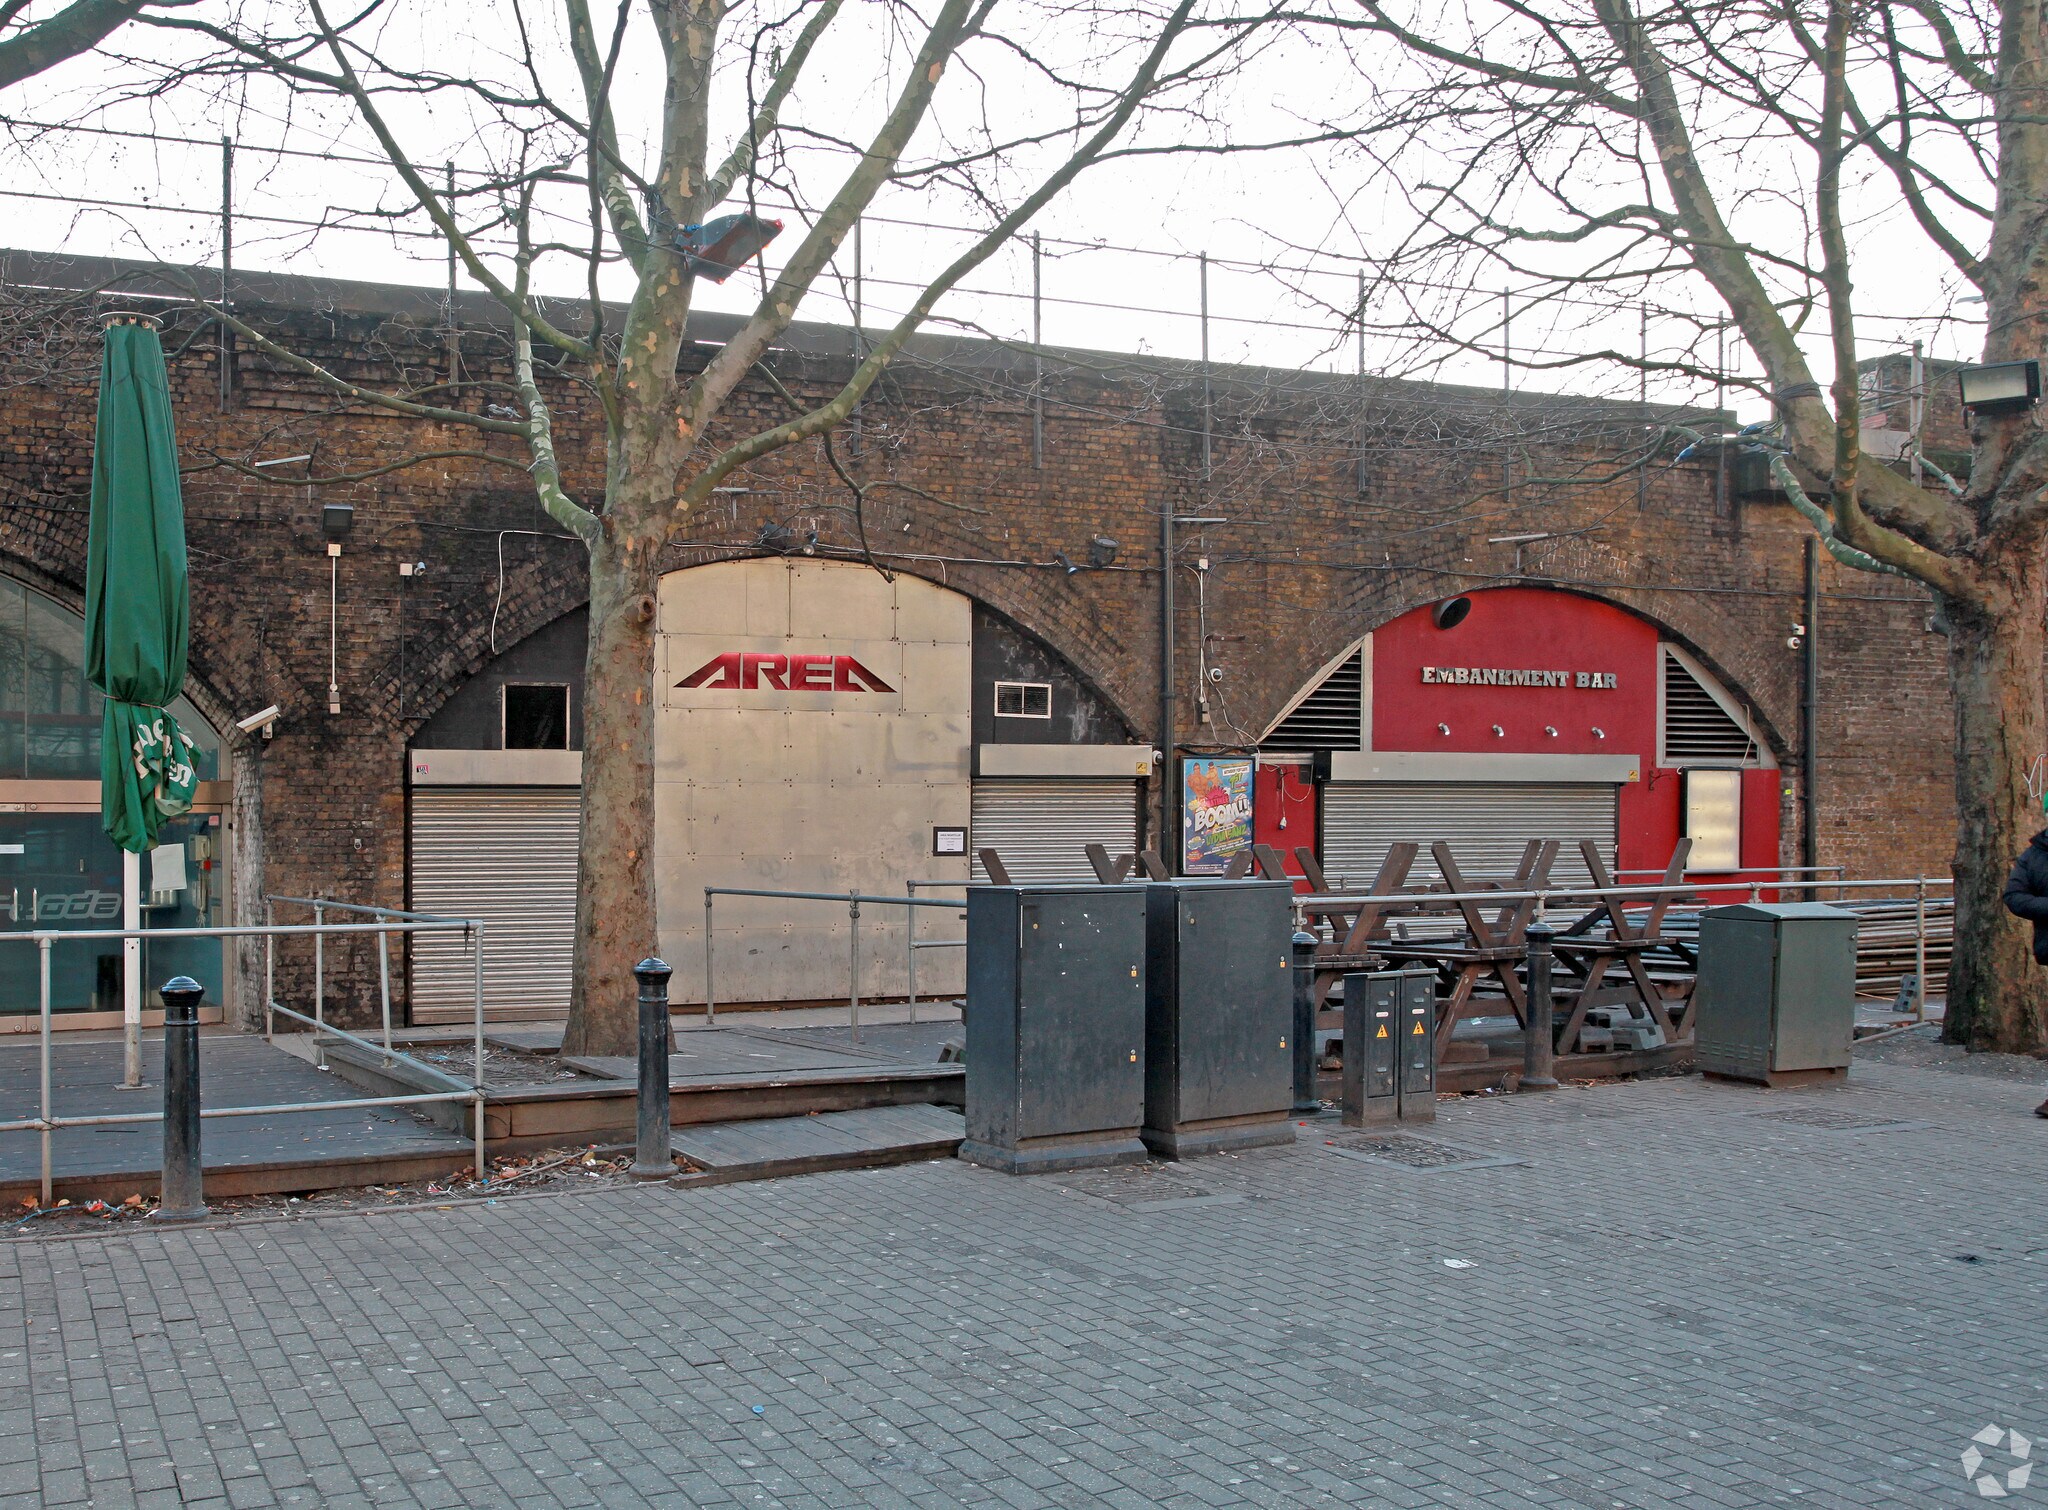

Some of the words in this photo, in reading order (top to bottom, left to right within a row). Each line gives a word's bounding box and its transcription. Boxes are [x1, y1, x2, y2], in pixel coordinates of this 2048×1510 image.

[673, 652, 898, 693] AREA
[1421, 666, 1569, 688] EMBANKMENT
[1575, 671, 1618, 689] BAR
